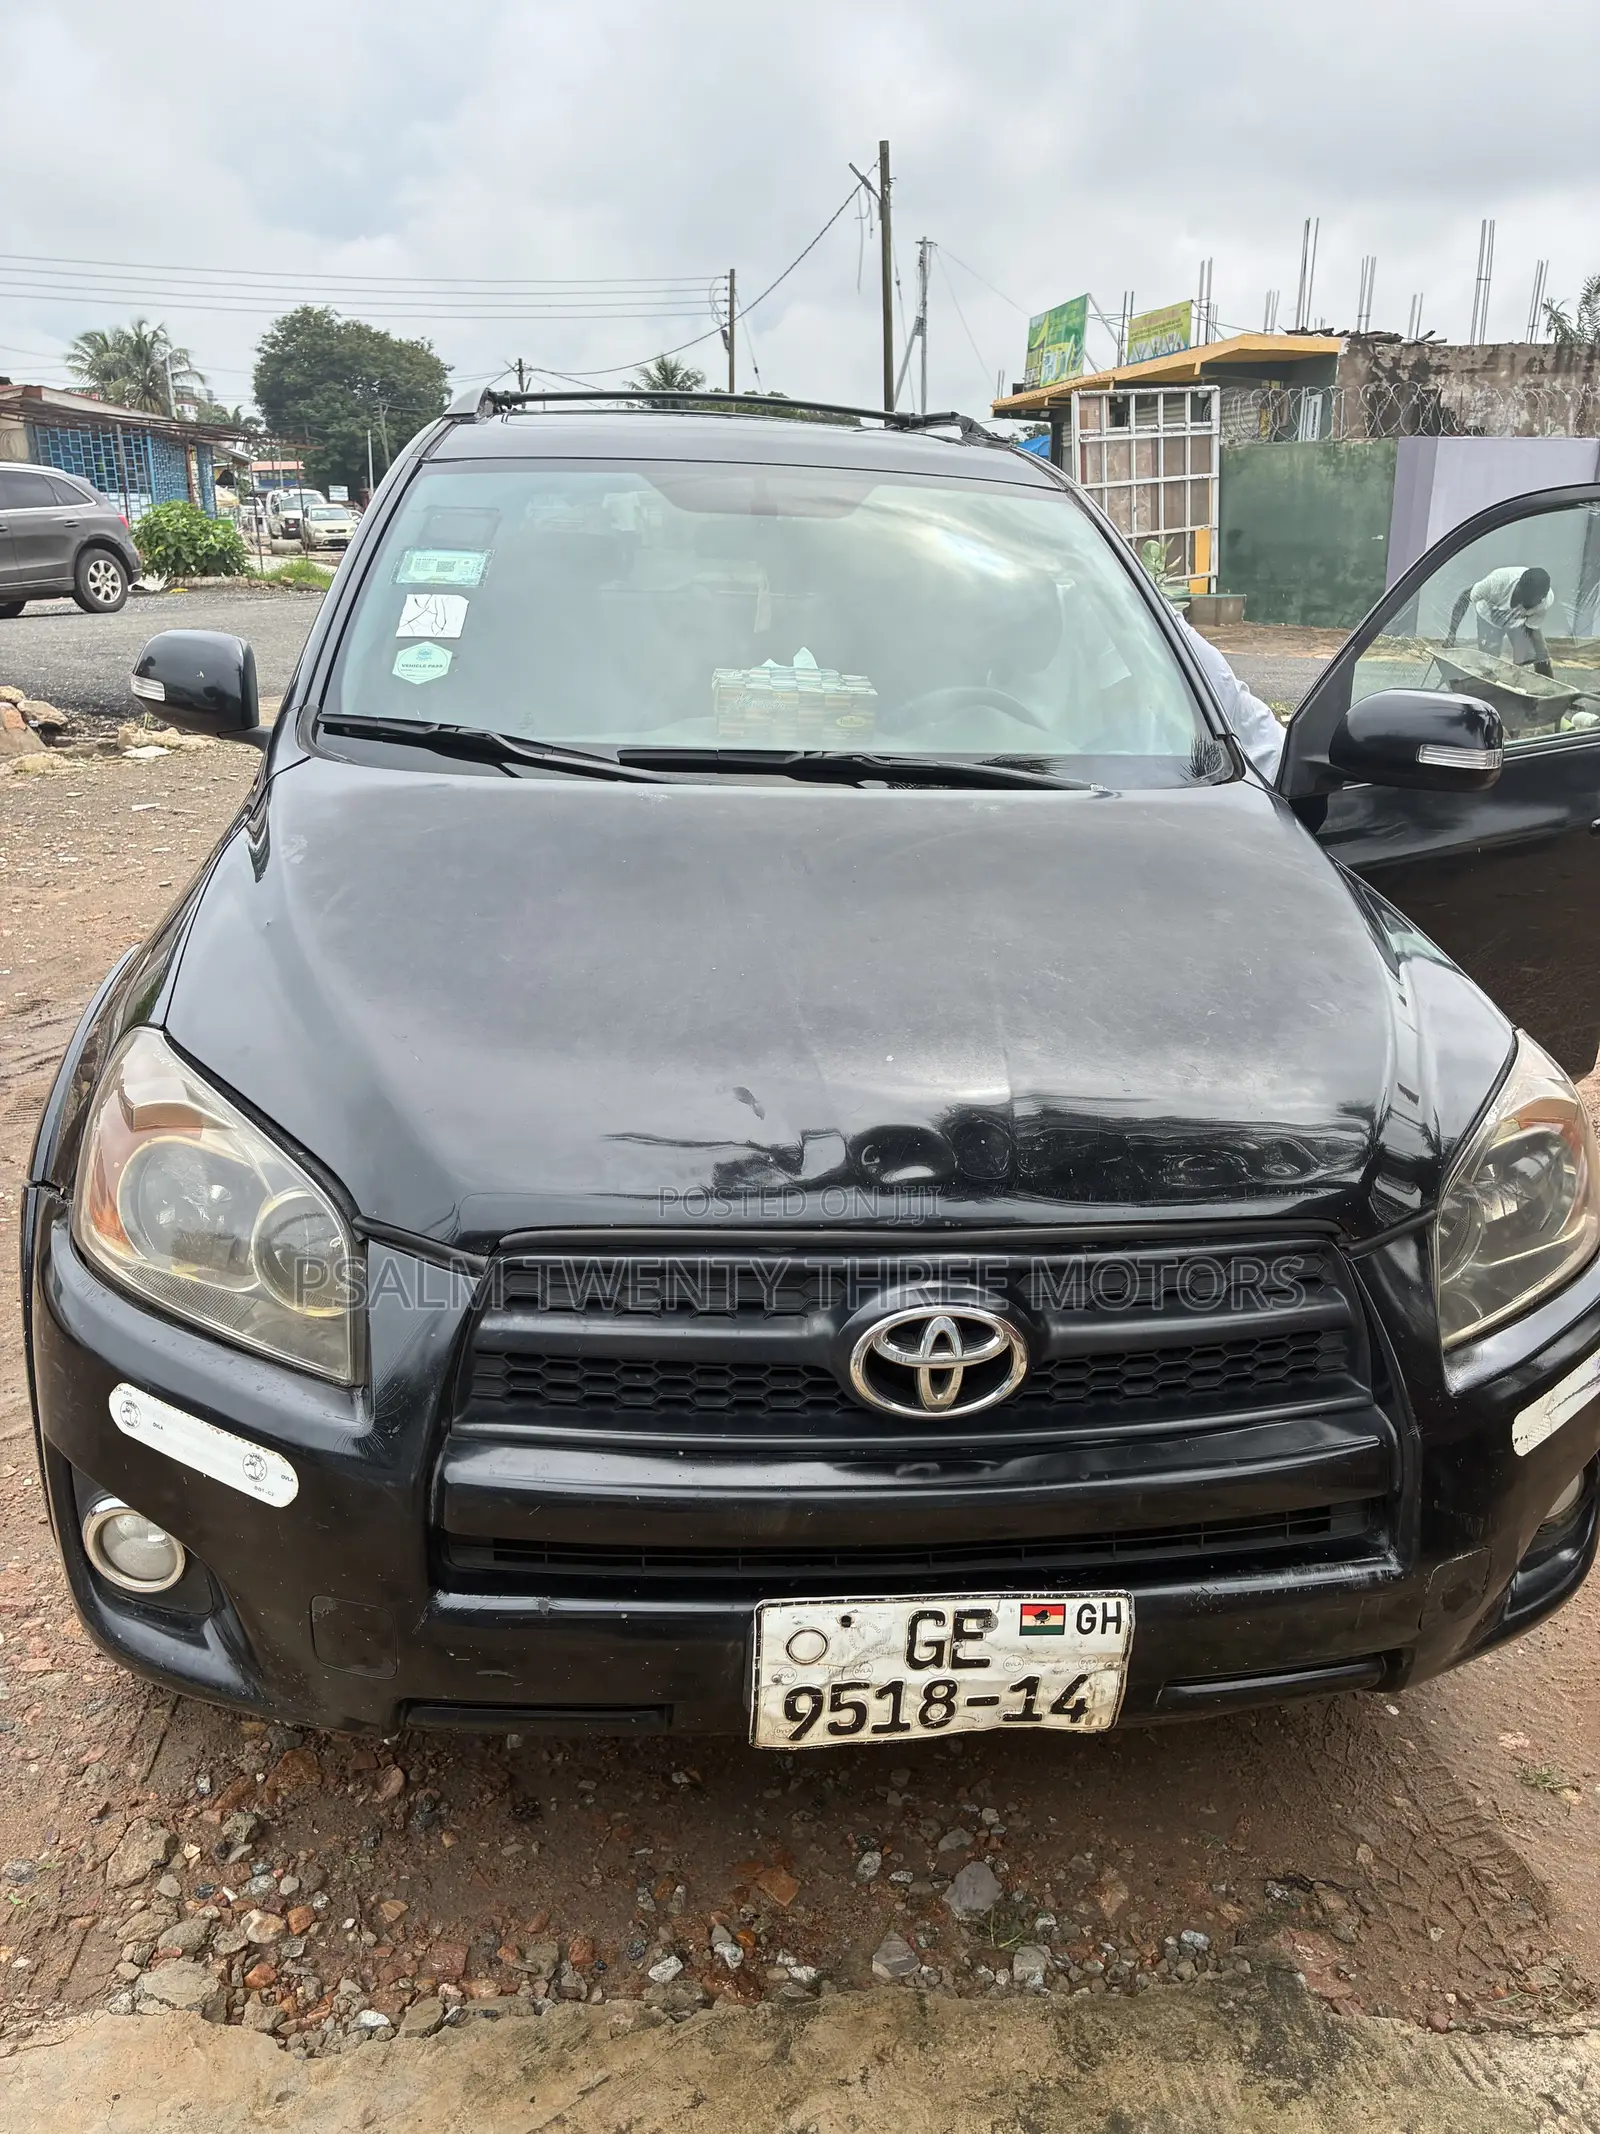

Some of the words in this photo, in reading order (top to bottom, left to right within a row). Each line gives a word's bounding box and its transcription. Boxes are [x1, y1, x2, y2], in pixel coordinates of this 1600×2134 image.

[152, 1421, 164, 1431] DVLA
[280, 1474, 294, 1483] DVLA
[1076, 1601, 1122, 1635] GH
[904, 1607, 994, 1671] GE
[783, 1673, 1090, 1742] 9518-14
